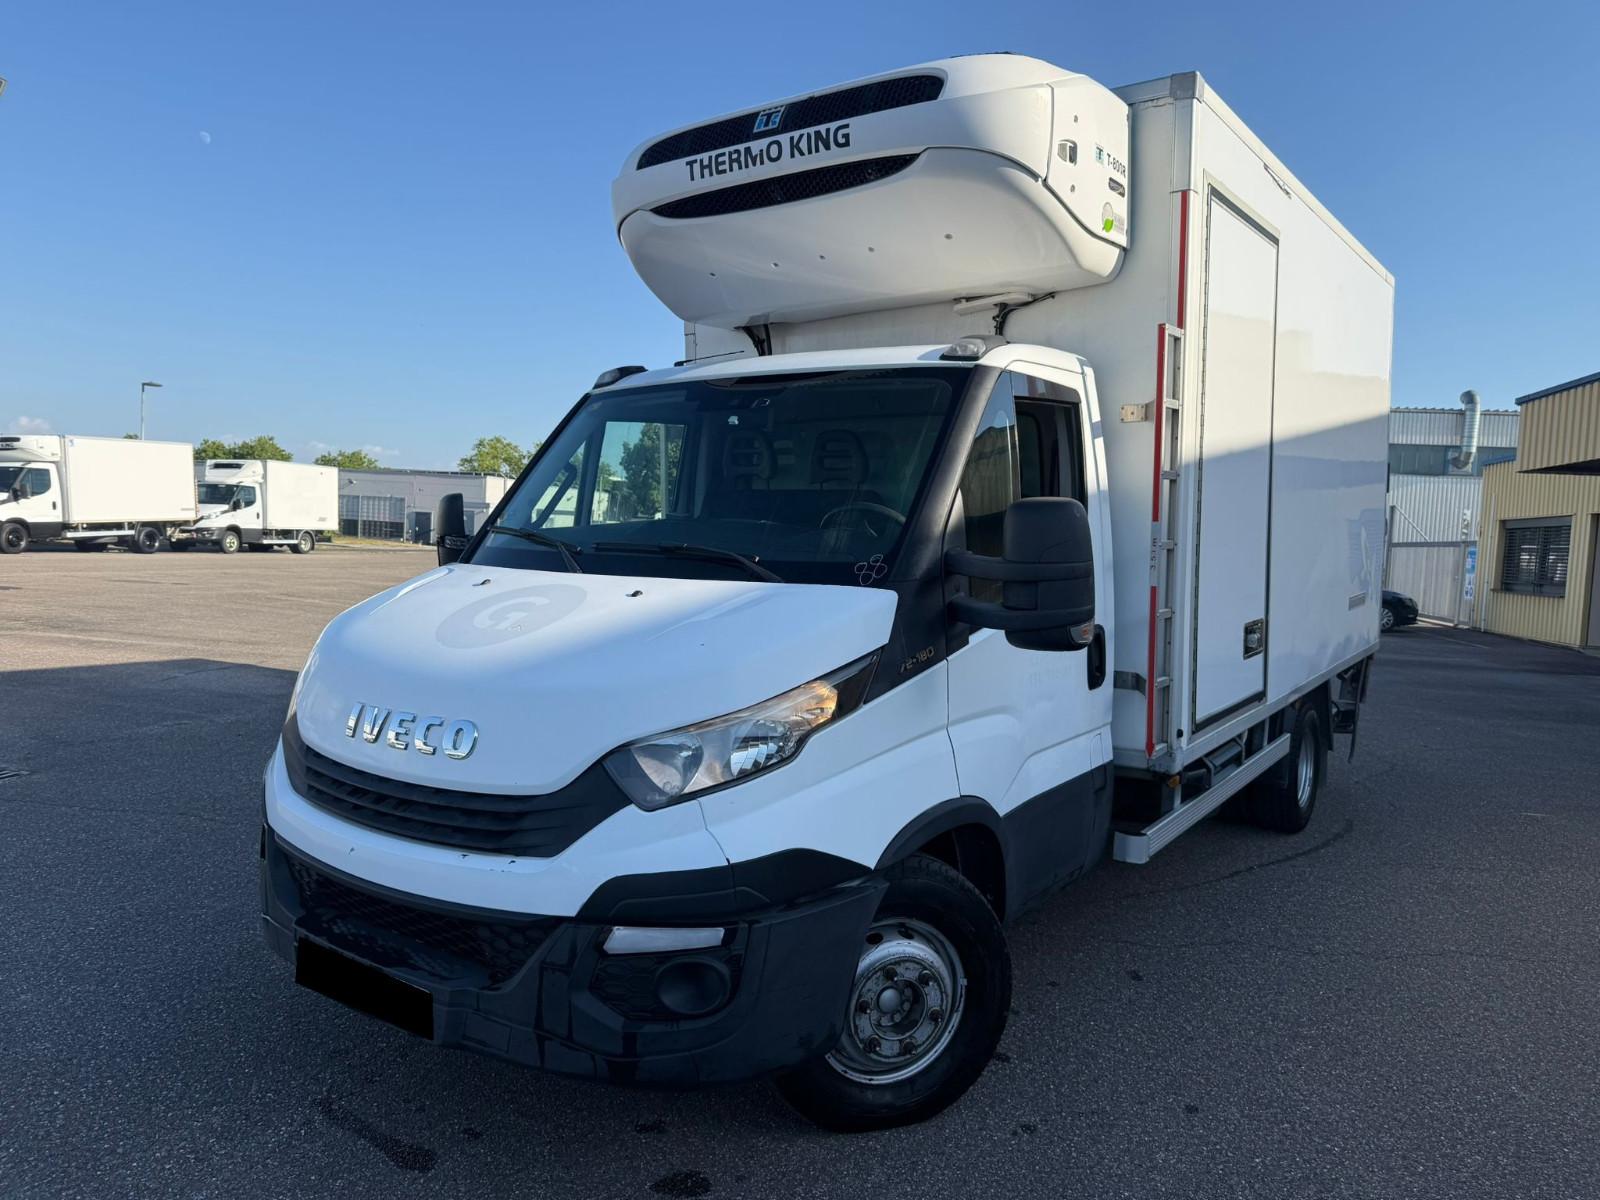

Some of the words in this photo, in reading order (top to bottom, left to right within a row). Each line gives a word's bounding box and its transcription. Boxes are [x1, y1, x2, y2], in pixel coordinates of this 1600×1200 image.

[686, 140, 783, 181] THERMO
[789, 124, 851, 159] KING
[854, 554, 888, 585] 88
[344, 702, 479, 760] IVECO
